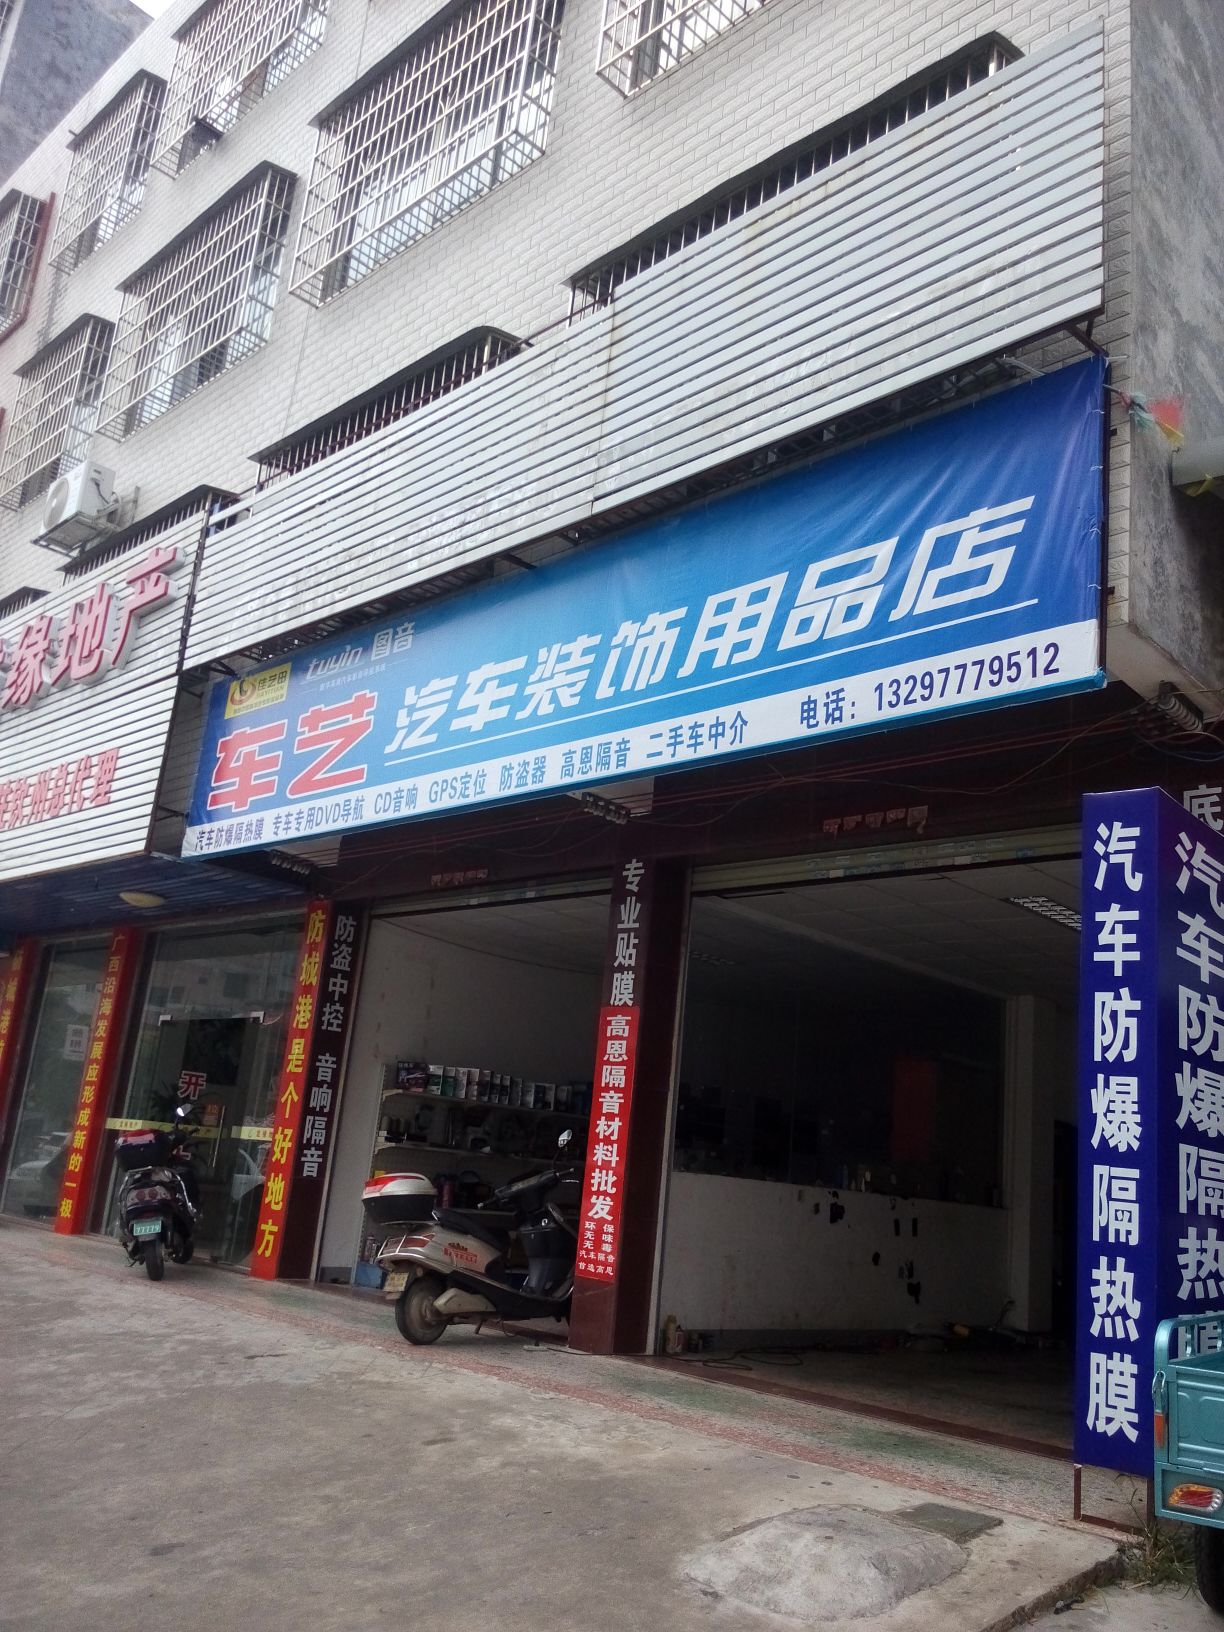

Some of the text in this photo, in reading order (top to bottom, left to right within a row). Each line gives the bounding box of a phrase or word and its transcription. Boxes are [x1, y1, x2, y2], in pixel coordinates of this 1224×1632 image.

[0, 546, 184, 709] 缘地产
[383, 495, 1036, 755] 汽车装饰用品店
[194, 818, 265, 852] 汽车防爆隔热膜
[374, 784, 418, 815] CD音响
[428, 771, 488, 804] GPS定位
[499, 755, 548, 792] 防盗器
[560, 737, 632, 781] 高恩隔音
[646, 710, 749, 760] 二手车中介
[873, 642, 1060, 712] 13297779512
[206, 689, 379, 813] 车艺
[609, 858, 645, 1007] 专业贴膜
[256, 910, 326, 1258] 防城港是个好地方
[300, 914, 358, 1178] 防盗中控 音响隔音
[587, 1014, 632, 1220] 高恩隔音材料批发
[1086, 821, 1143, 1444] 汽车防爆隔热膜
